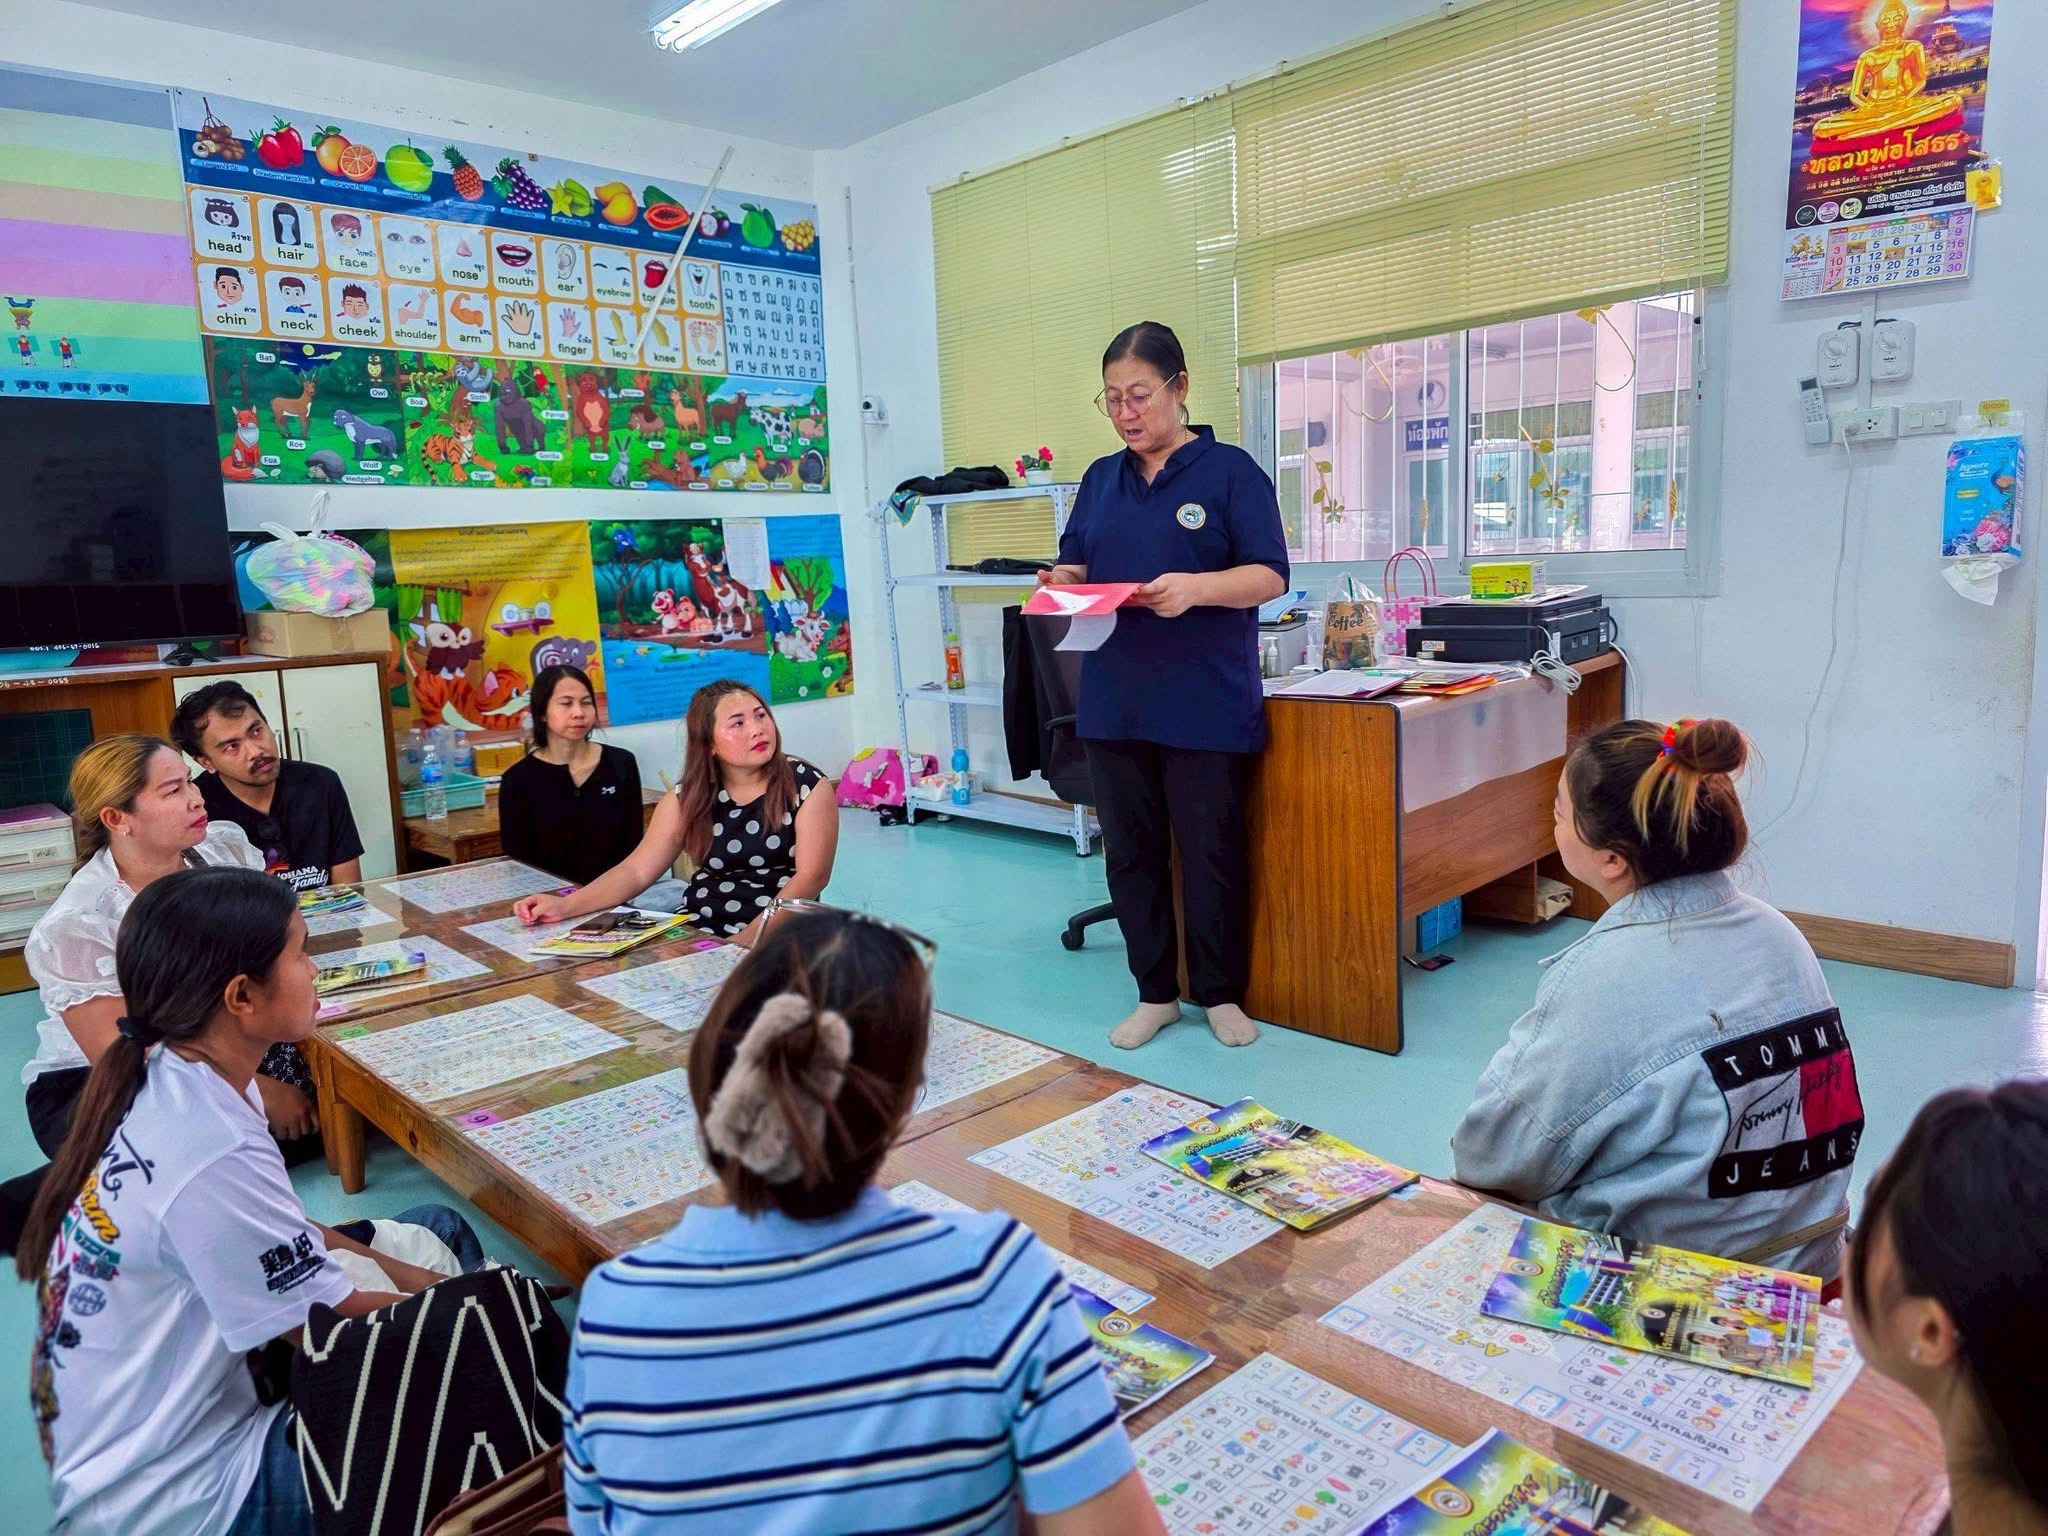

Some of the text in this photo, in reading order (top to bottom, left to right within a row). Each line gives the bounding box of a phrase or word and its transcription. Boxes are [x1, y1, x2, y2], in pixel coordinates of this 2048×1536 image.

[1811, 129, 1961, 174] หลวงพ่อโสธร
[1868, 192, 1887, 204] บริษัท
[208, 240, 242, 253] head
[278, 247, 304, 260] hair
[1831, 258, 1842, 266] 10
[1910, 246, 1922, 254] 14
[1930, 243, 1943, 251] 15
[338, 255, 368, 268] face
[1887, 261, 1900, 269] 20
[1928, 255, 1941, 263] 22
[1949, 252, 1962, 260] 23
[400, 264, 421, 274] eye
[453, 269, 479, 280] nose
[1846, 278, 1859, 286] 25
[1906, 269, 1919, 278] 28
[1926, 266, 1940, 274] 29
[1946, 263, 1961, 272] 30
[498, 275, 534, 287] mouth
[558, 283, 575, 292] ear
[596, 288, 631, 298] eyebrow
[689, 300, 715, 310] tooth
[216, 312, 247, 325] chin
[280, 320, 314, 331] neck
[339, 324, 378, 337] cheek
[395, 329, 437, 340] shoulder
[459, 334, 482, 343] arm
[508, 339, 536, 351] hand
[558, 343, 587, 356] finger
[612, 348, 628, 360] leg
[653, 353, 676, 364] knee
[696, 355, 716, 367] foot
[1328, 612, 1363, 629] Coffee
[290, 869, 328, 892] Family
[1724, 1020, 1846, 1076] TOMMY
[1726, 1134, 1857, 1185] JEANS
[1448, 1329, 1509, 1357] A-Z
[1584, 1390, 1604, 1404] ตัว
[1320, 1390, 1331, 1399] 2
[1352, 1406, 1363, 1414] 3
[1382, 1421, 1392, 1430] 4
[1416, 1438, 1428, 1448] 5
[1256, 1396, 1332, 1438] พยัญชนะไทย
[1356, 1447, 1375, 1461] ตัว
[1631, 1410, 1730, 1455] พยัญชนะไทย
[1610, 1435, 1623, 1444] 3
[1650, 1452, 1661, 1462] 2
[1694, 1471, 1700, 1480] 1
[1733, 1488, 1745, 1498] 0
